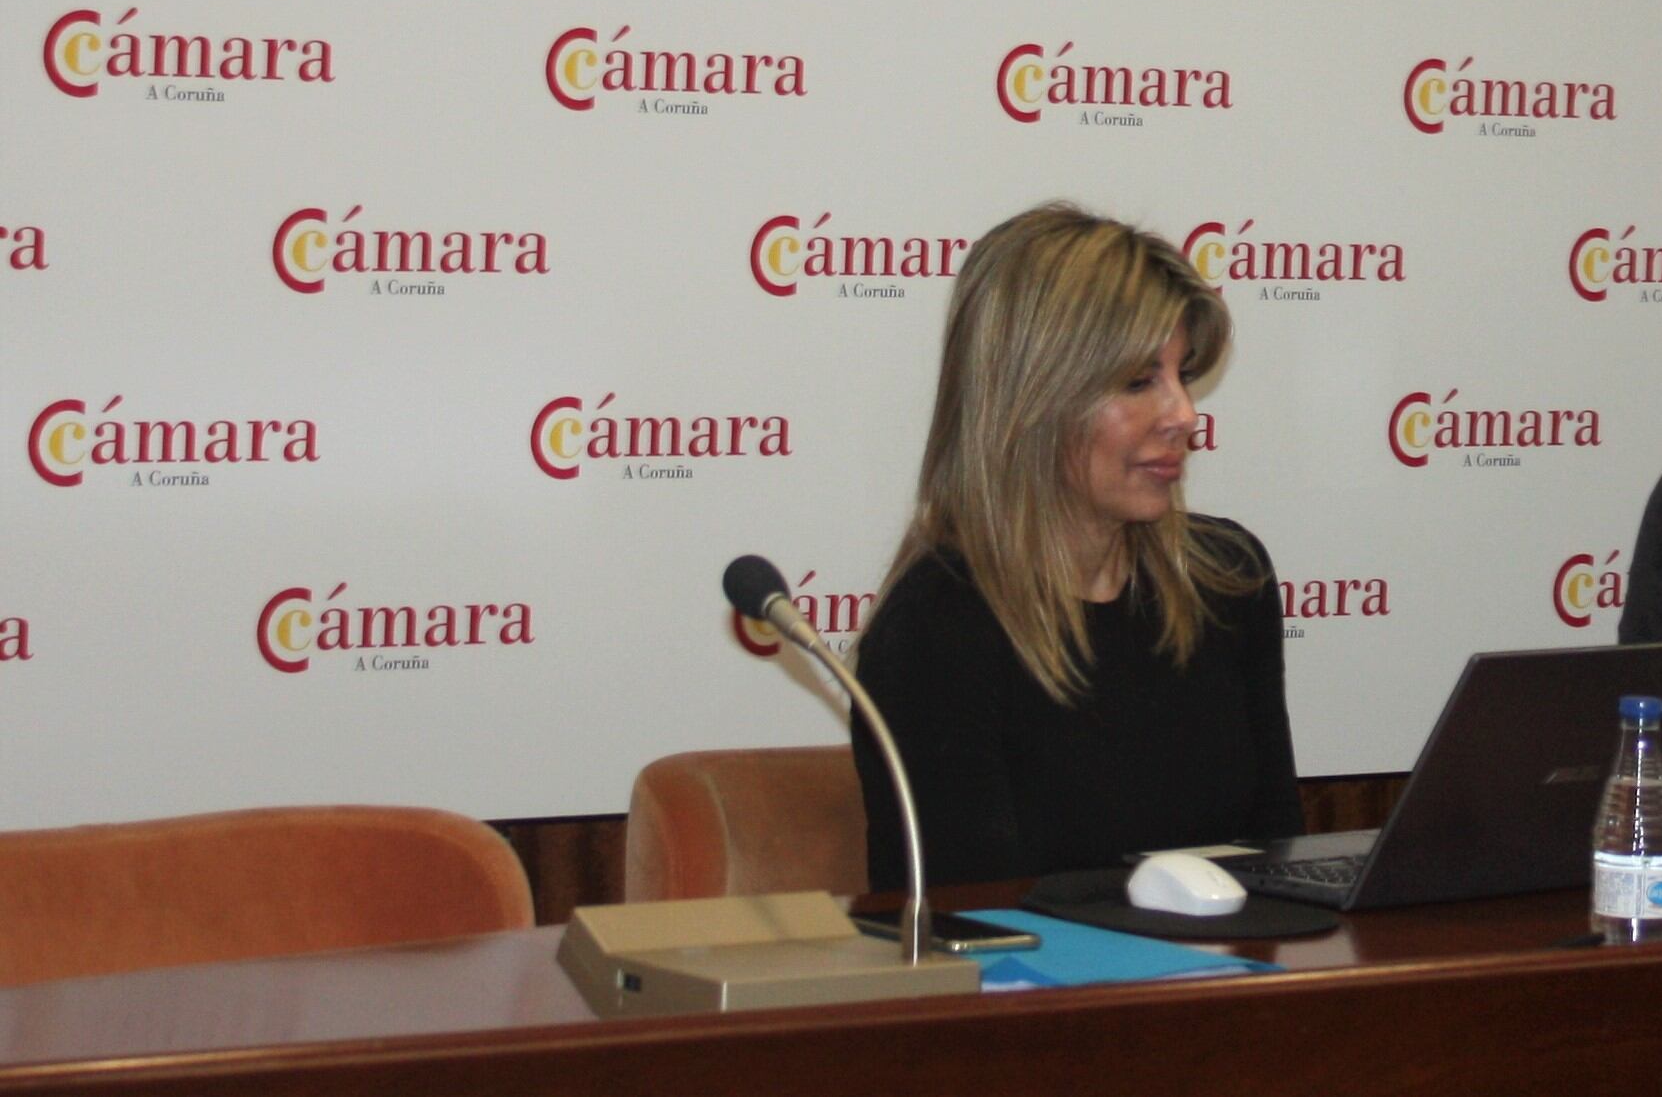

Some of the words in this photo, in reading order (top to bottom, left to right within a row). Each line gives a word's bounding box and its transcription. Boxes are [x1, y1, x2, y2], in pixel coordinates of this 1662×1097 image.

[145, 85, 159, 101] A
[163, 85, 225, 103] Coruña
[638, 98, 649, 114] A
[653, 98, 709, 116] Coruña
[1079, 111, 1090, 126] A
[1093, 111, 1144, 127] Coruña
[1479, 122, 1488, 136] A
[1491, 122, 1537, 138] Coruña
[370, 279, 382, 295] A
[386, 279, 445, 296] Coruña
[838, 283, 849, 298] A
[852, 283, 905, 299] Coruña
[1259, 286, 1269, 301] A
[1272, 286, 1321, 301] Coruña
[1640, 290, 1649, 303] A
[1463, 454, 1473, 468] A
[1476, 453, 1521, 468] Coruña
[131, 470, 143, 487] A
[148, 470, 210, 487] Coruña
[622, 464, 634, 480] A
[637, 463, 694, 480] Coruña
[354, 656, 367, 672] A
[371, 655, 430, 672] Coruña
